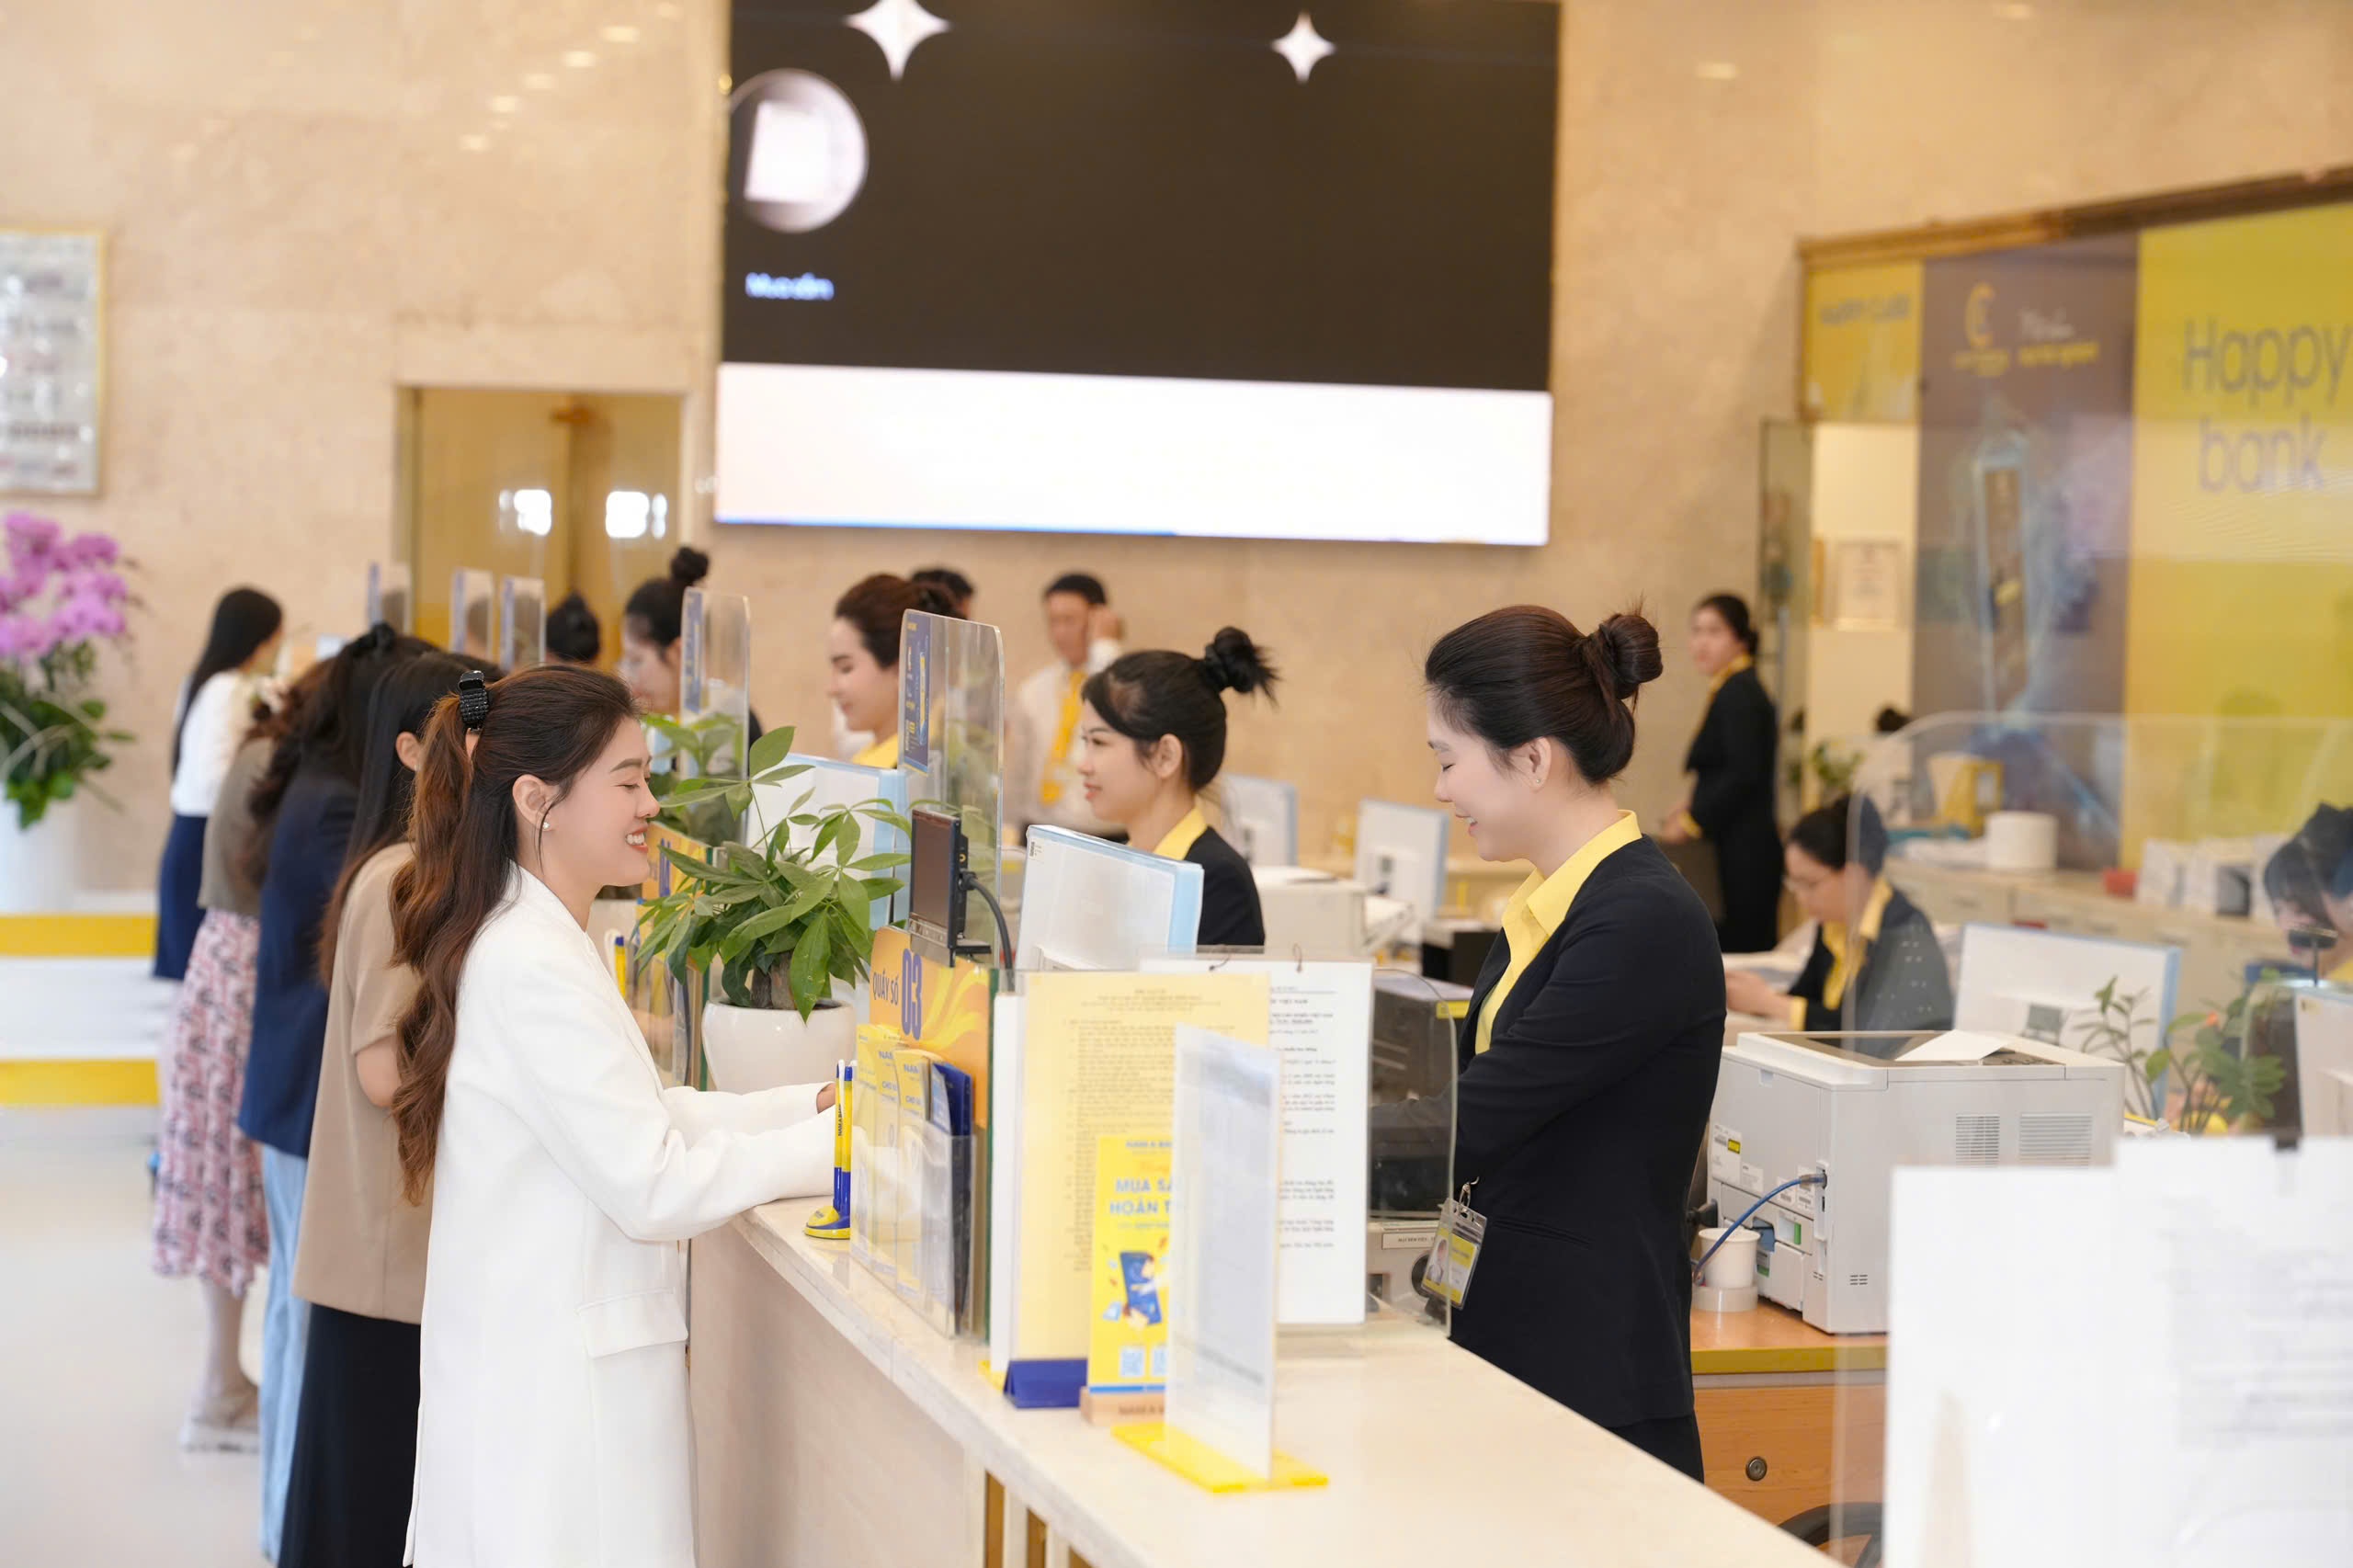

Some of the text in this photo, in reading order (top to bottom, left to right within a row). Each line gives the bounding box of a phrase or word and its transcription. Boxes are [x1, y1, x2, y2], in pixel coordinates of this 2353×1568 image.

[2182, 319, 2353, 410] Happy
[2198, 411, 2328, 494] bank
[902, 948, 922, 1040] 03
[1116, 1178, 1151, 1193] MUA
